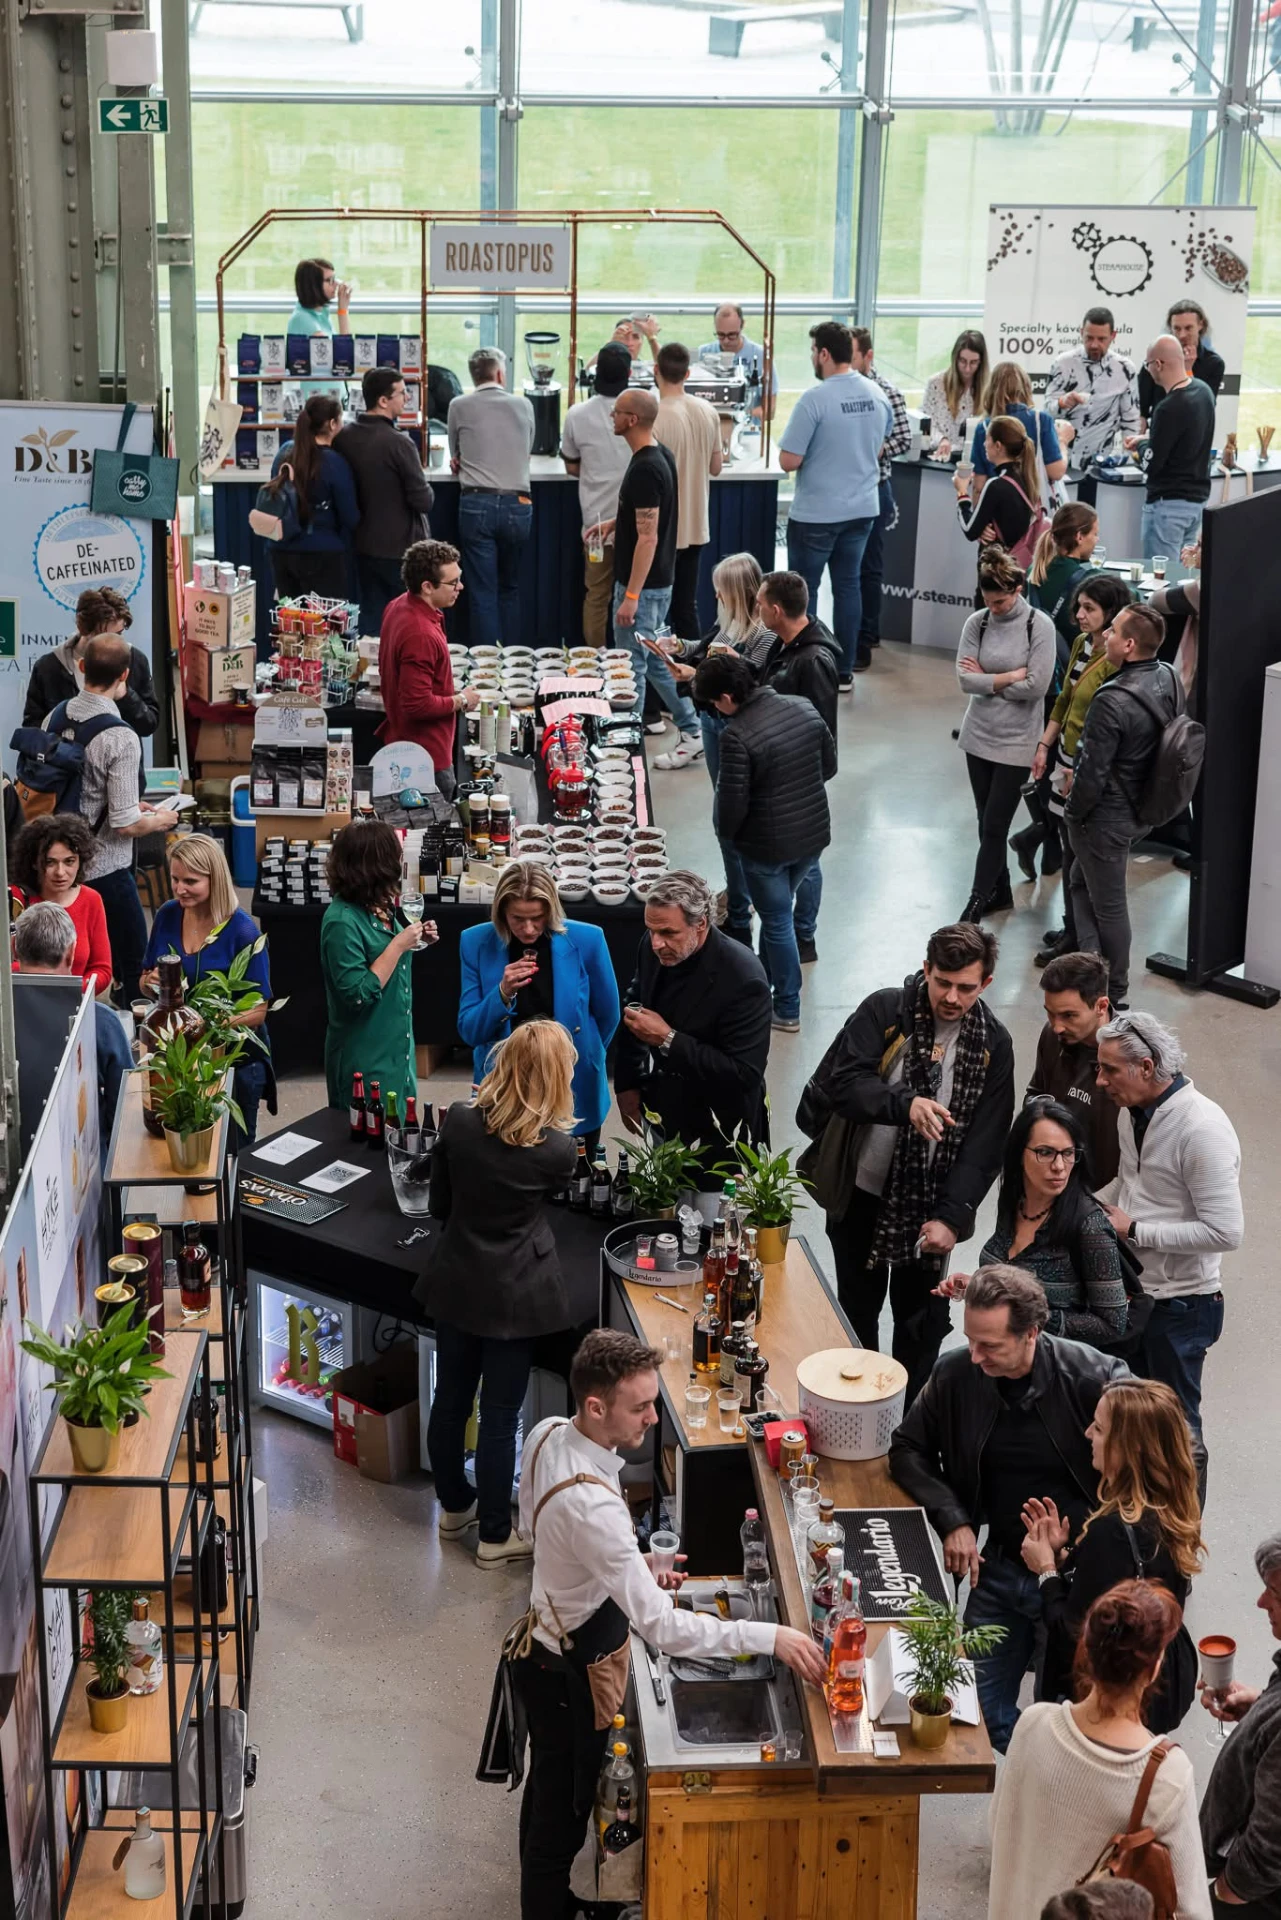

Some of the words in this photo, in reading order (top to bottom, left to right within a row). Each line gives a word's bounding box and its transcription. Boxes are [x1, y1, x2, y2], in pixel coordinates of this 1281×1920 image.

[445, 241, 554, 273] ROASTOPUS
[1000, 322, 1052, 336] Specialty
[1000, 337, 1054, 356] 100%
[76, 543, 99, 558] DE-
[46, 556, 136, 581] CAFFEINATED
[859, 1517, 922, 1598] Legendario
